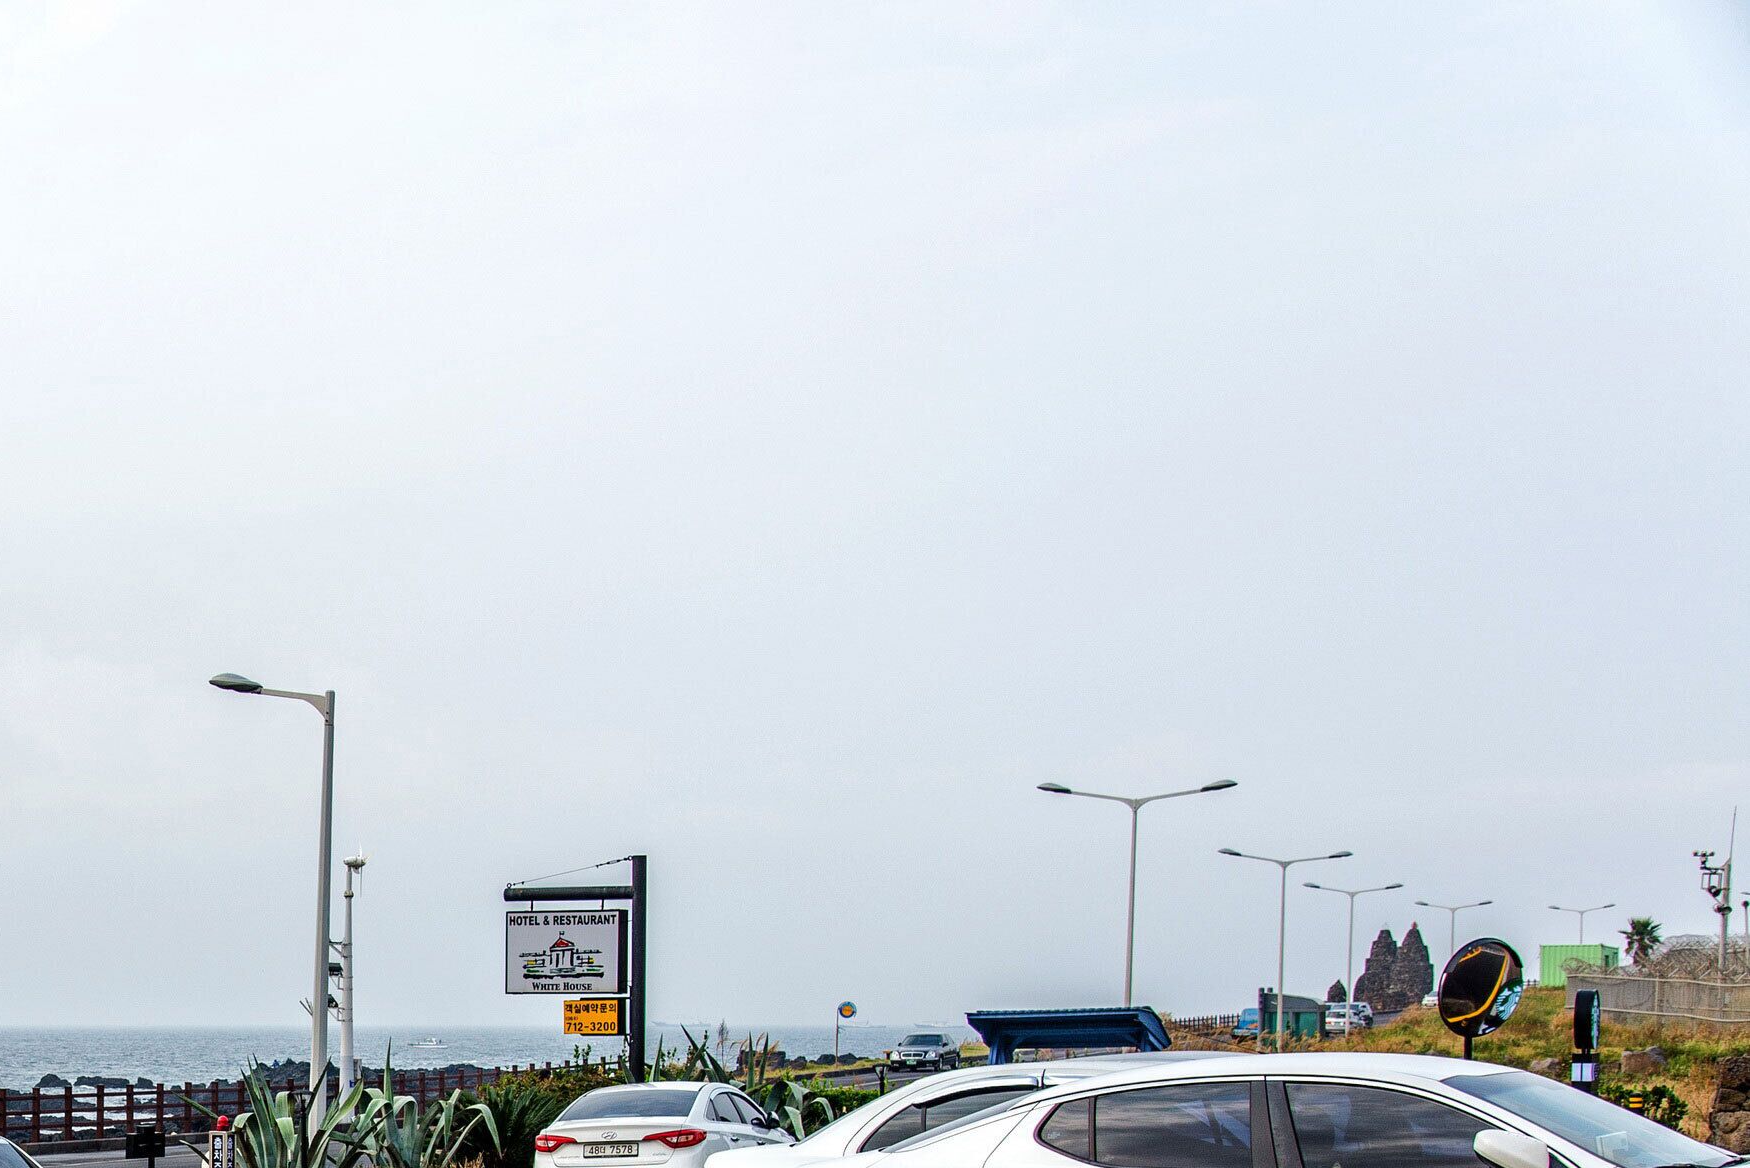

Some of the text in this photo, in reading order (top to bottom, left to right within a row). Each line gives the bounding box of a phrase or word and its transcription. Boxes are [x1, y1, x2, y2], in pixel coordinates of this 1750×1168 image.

[509, 914, 617, 926] HOTEL & RESTAURANT
[566, 1021, 616, 1032] 712-3200
[609, 1144, 633, 1154] 7578
